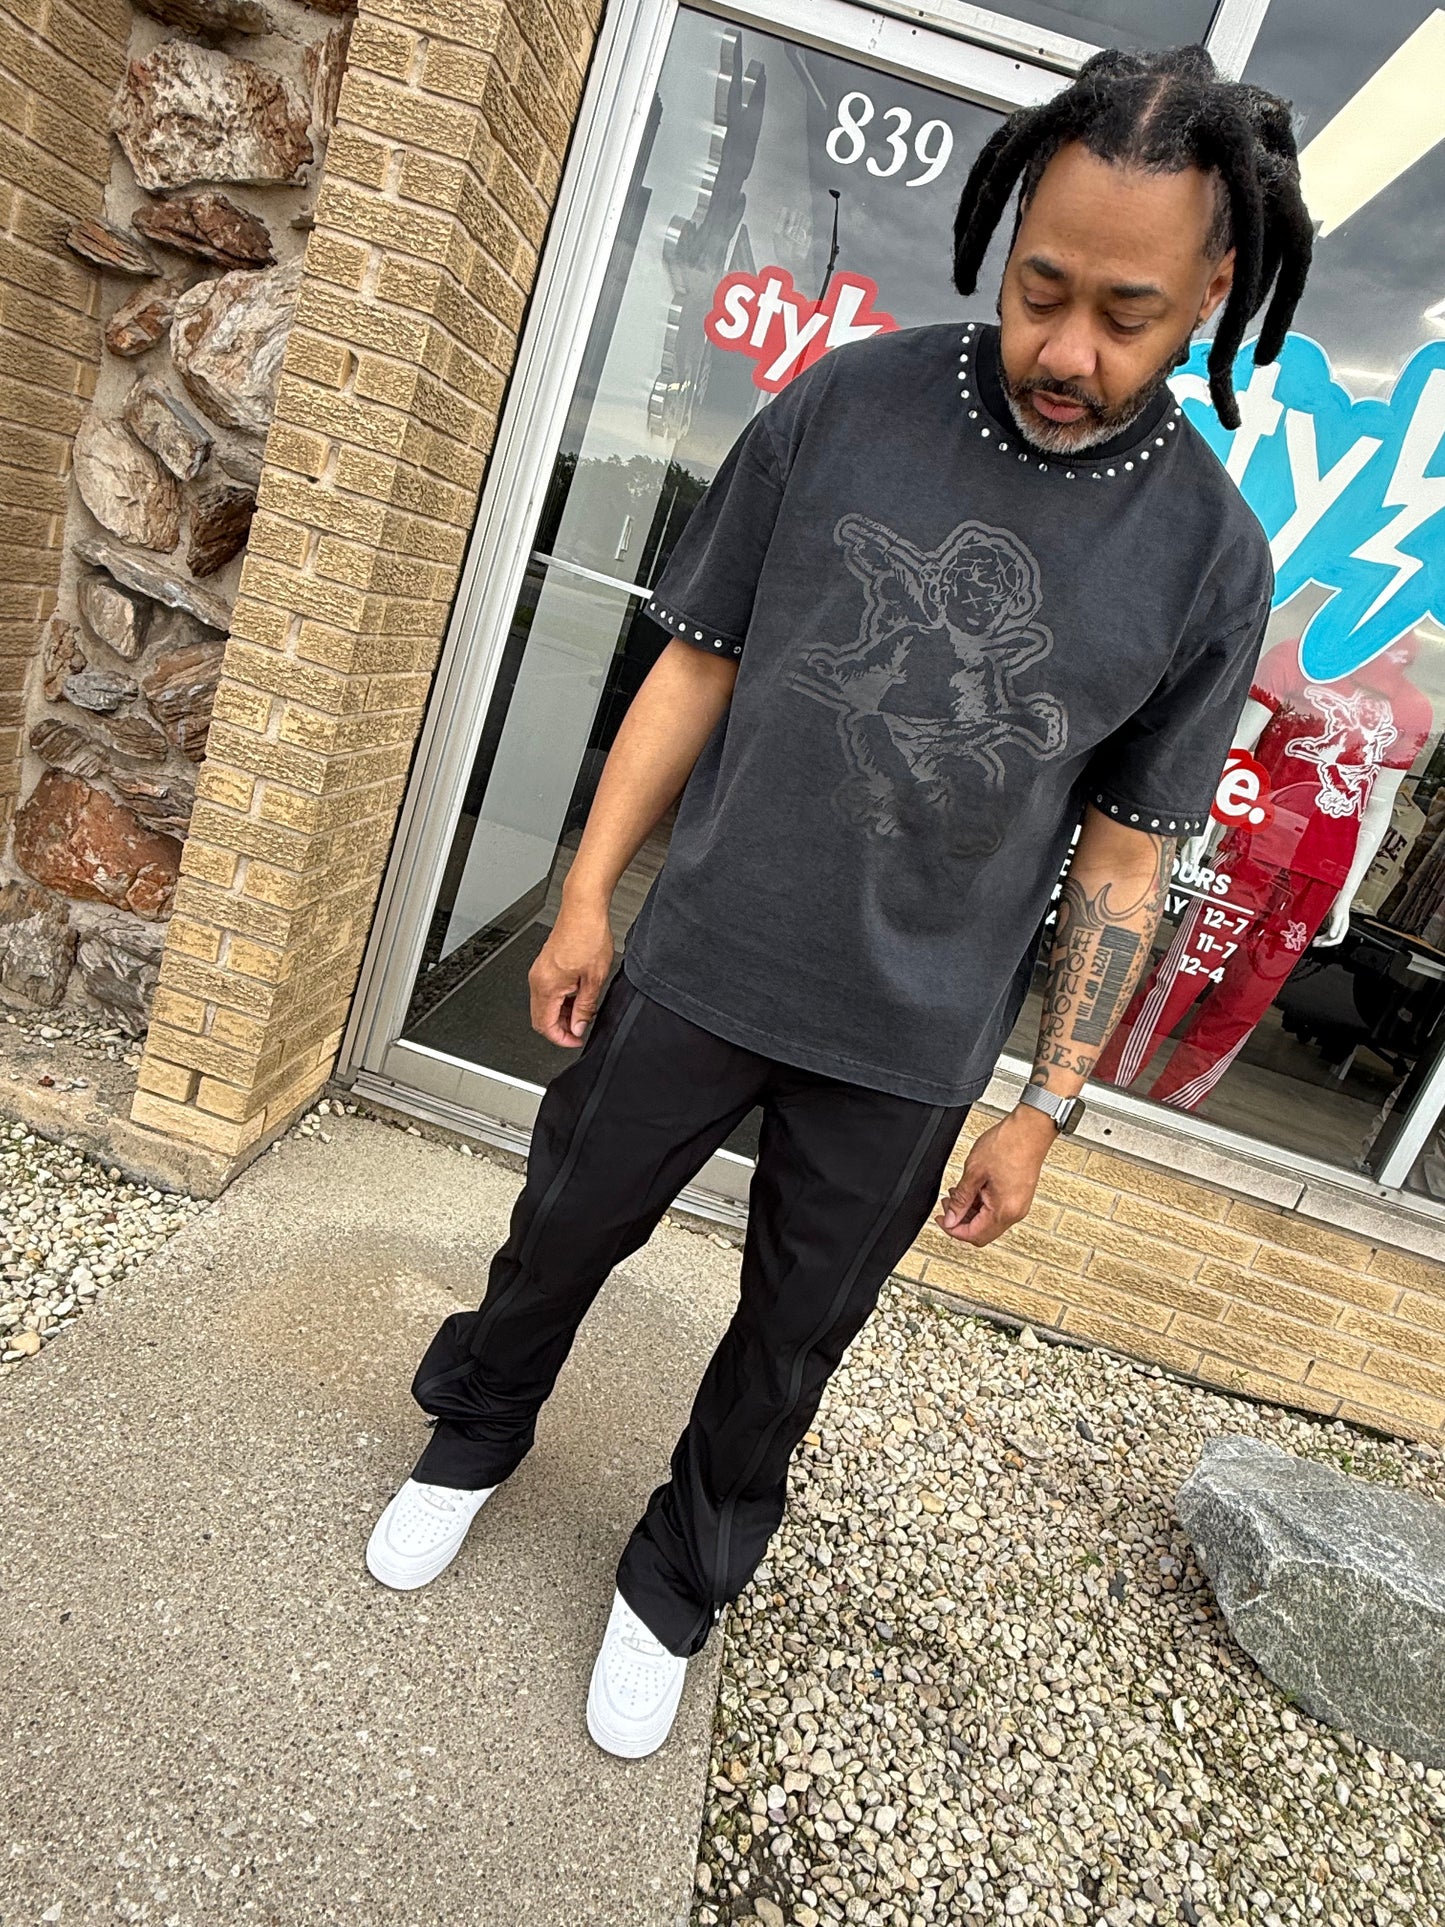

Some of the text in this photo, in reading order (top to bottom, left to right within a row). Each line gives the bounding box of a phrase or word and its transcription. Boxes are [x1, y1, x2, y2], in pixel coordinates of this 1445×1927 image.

[826, 91, 954, 187] 839
[1202, 907, 1250, 935] 12-7
[1196, 932, 1239, 959] 11-7
[1045, 928, 1095, 1039] HONOR
[1179, 954, 1226, 984] 12-4
